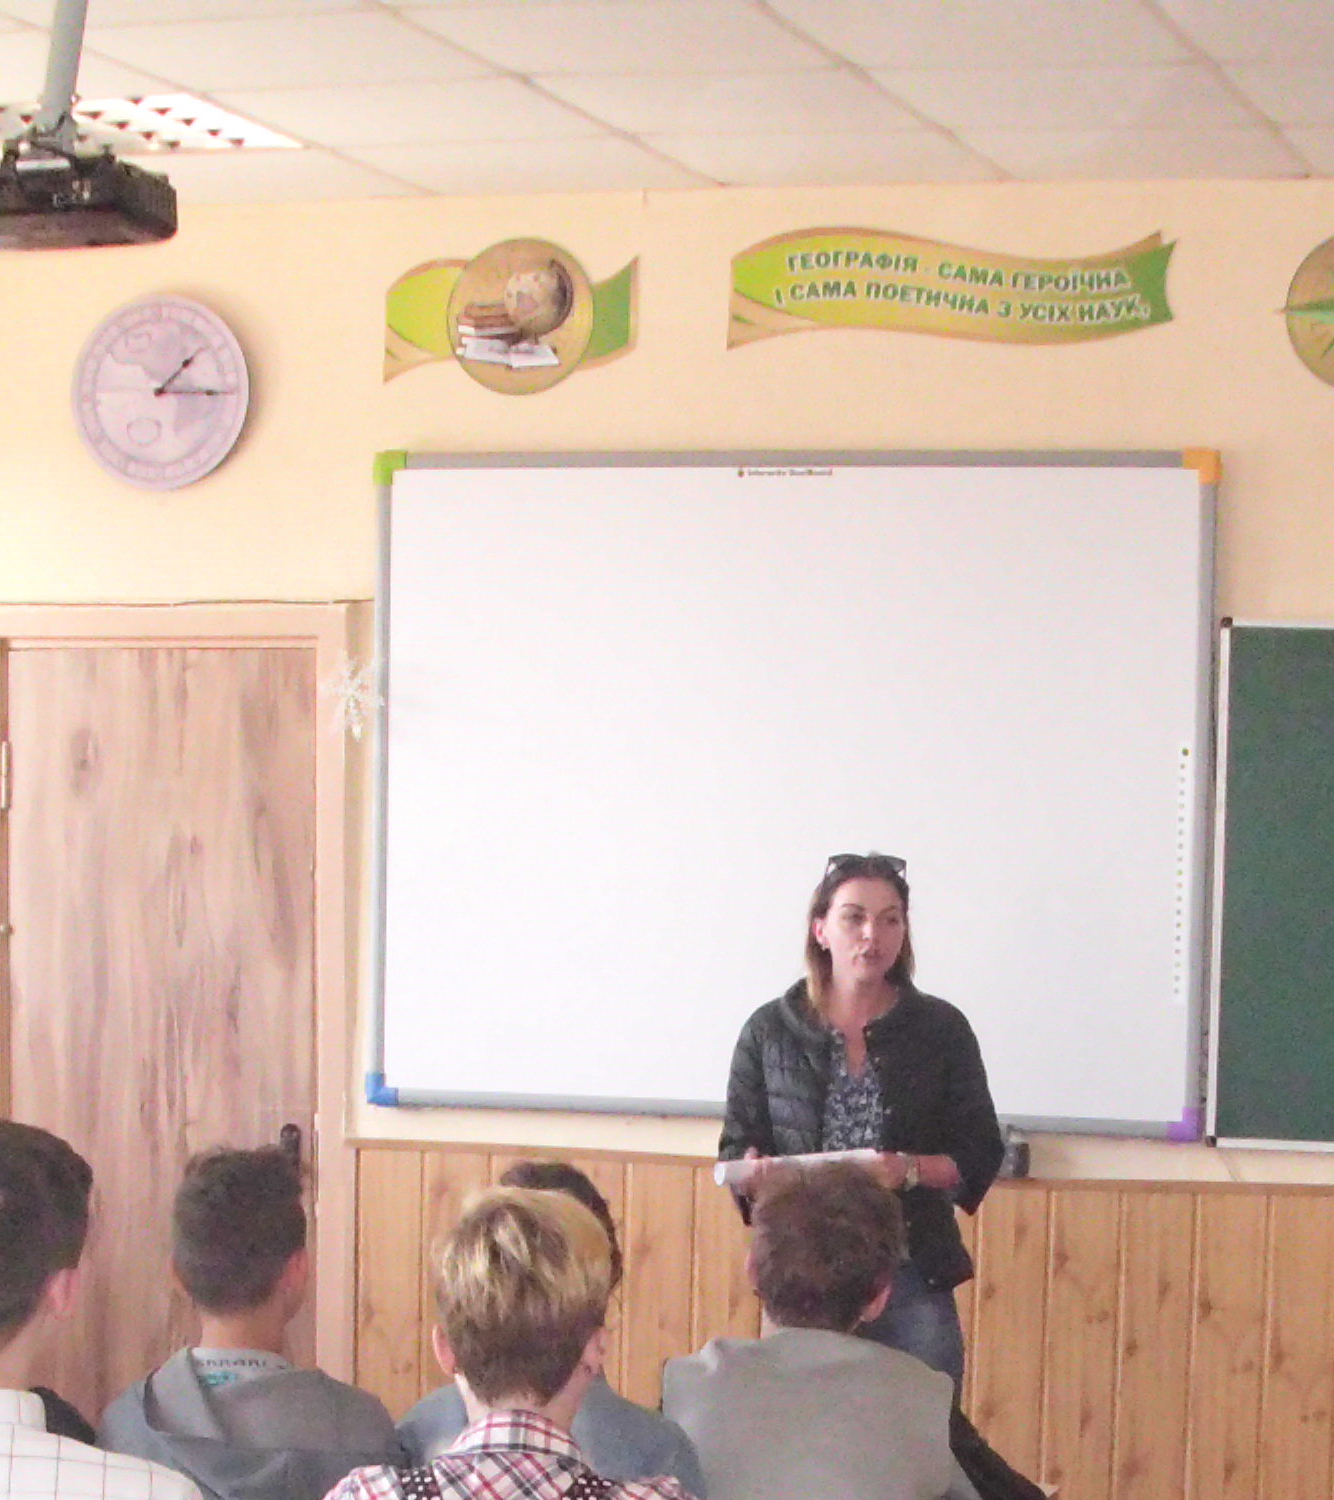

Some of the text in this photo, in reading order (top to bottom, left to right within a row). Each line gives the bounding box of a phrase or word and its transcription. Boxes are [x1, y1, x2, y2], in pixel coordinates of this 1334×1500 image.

[787, 250, 919, 273] ГЕОГРАФІЯ
[937, 261, 1005, 288] САМА
[1011, 267, 1131, 292] ГЕРОЇЧНА
[774, 286, 784, 306] І
[790, 280, 857, 300] САМА
[866, 280, 990, 316] ПОЕТИЧНА
[1019, 303, 1071, 323] УСІХ
